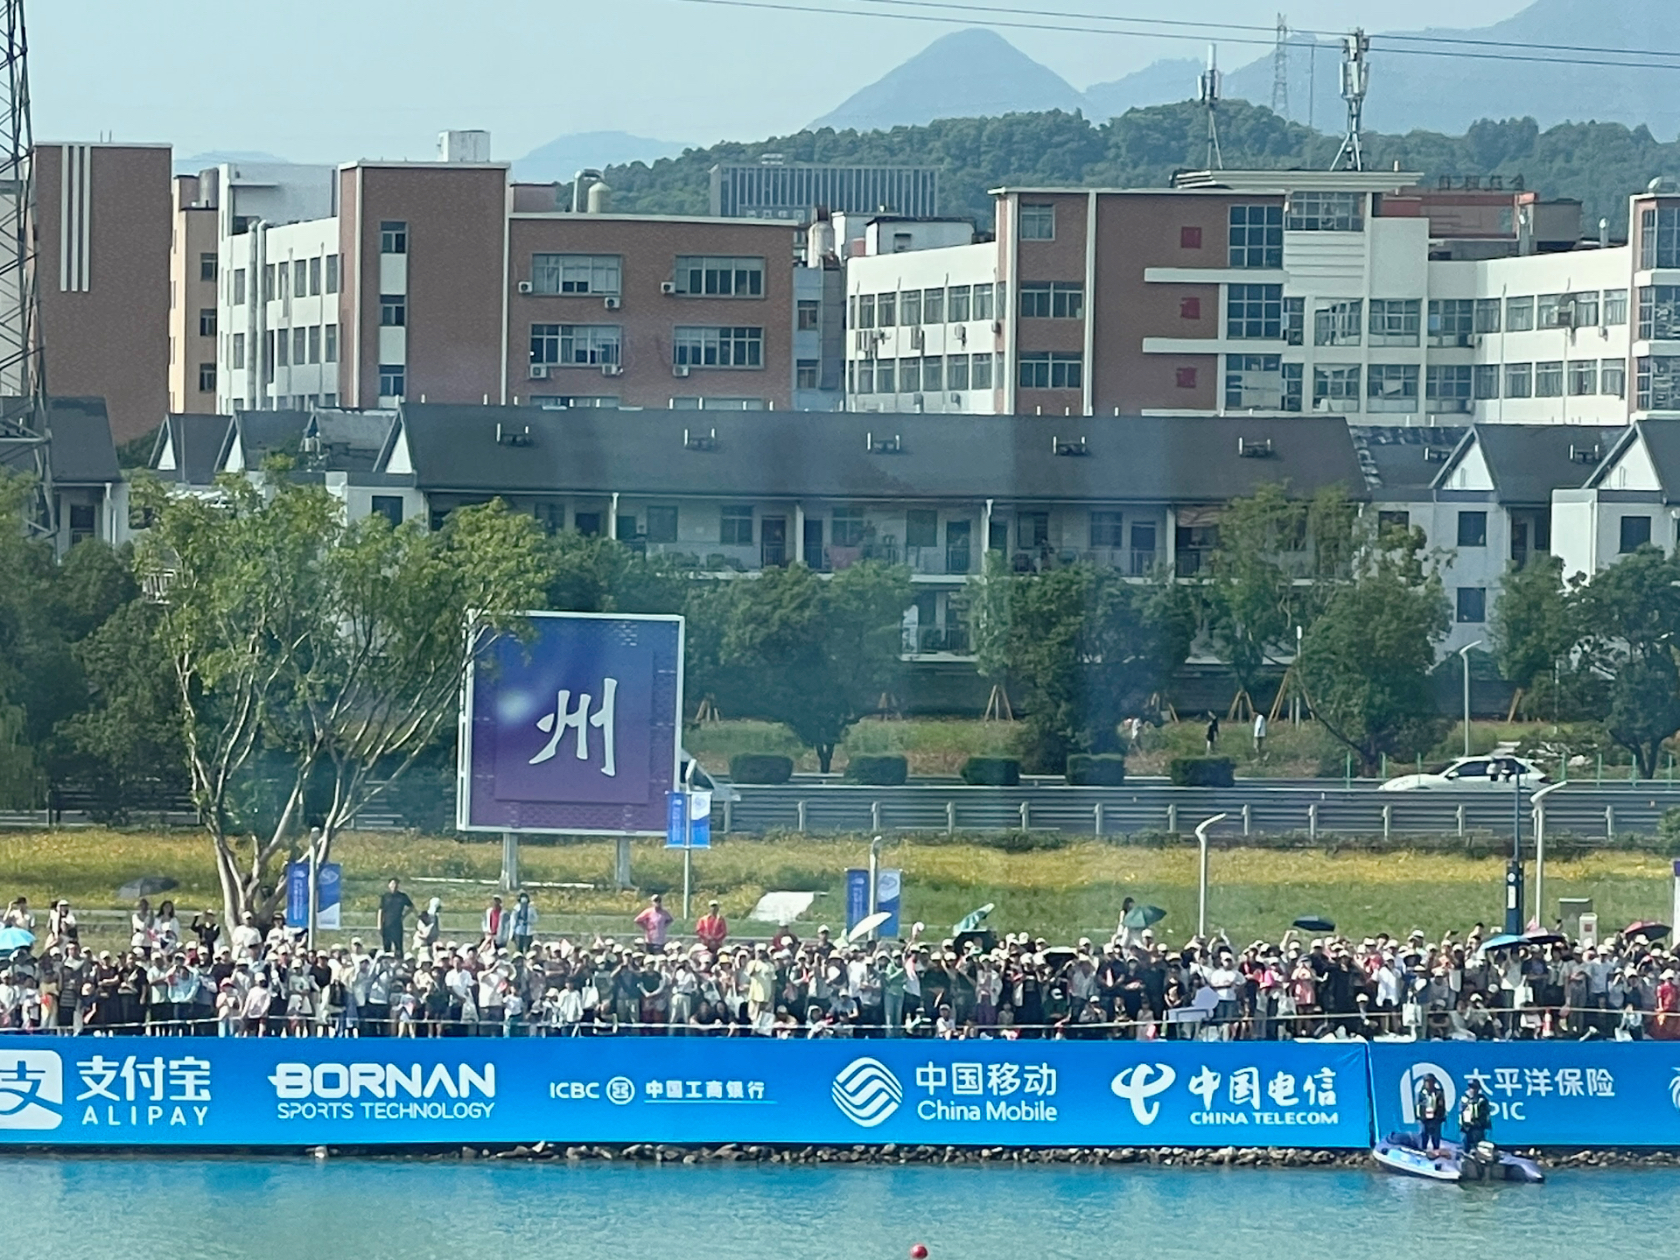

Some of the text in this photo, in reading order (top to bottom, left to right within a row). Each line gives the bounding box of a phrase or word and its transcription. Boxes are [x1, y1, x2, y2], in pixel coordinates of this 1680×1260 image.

[528, 677, 618, 777] 州
[76, 1055, 213, 1102] 支付宝
[266, 1061, 497, 1100] BORNAN
[549, 1081, 601, 1099] ICBC
[644, 1079, 766, 1100] 中国工商银行
[915, 1060, 1058, 1097] 中国移动
[1187, 1065, 1338, 1109] 中国电信
[1463, 1067, 1616, 1097] 太平洋保险
[82, 1105, 209, 1127] ALIPAY
[277, 1101, 496, 1120] SPORTS TECHNOLOGY
[917, 1099, 1059, 1122] China Mobile
[1190, 1110, 1340, 1126] CHINA TELECOM
